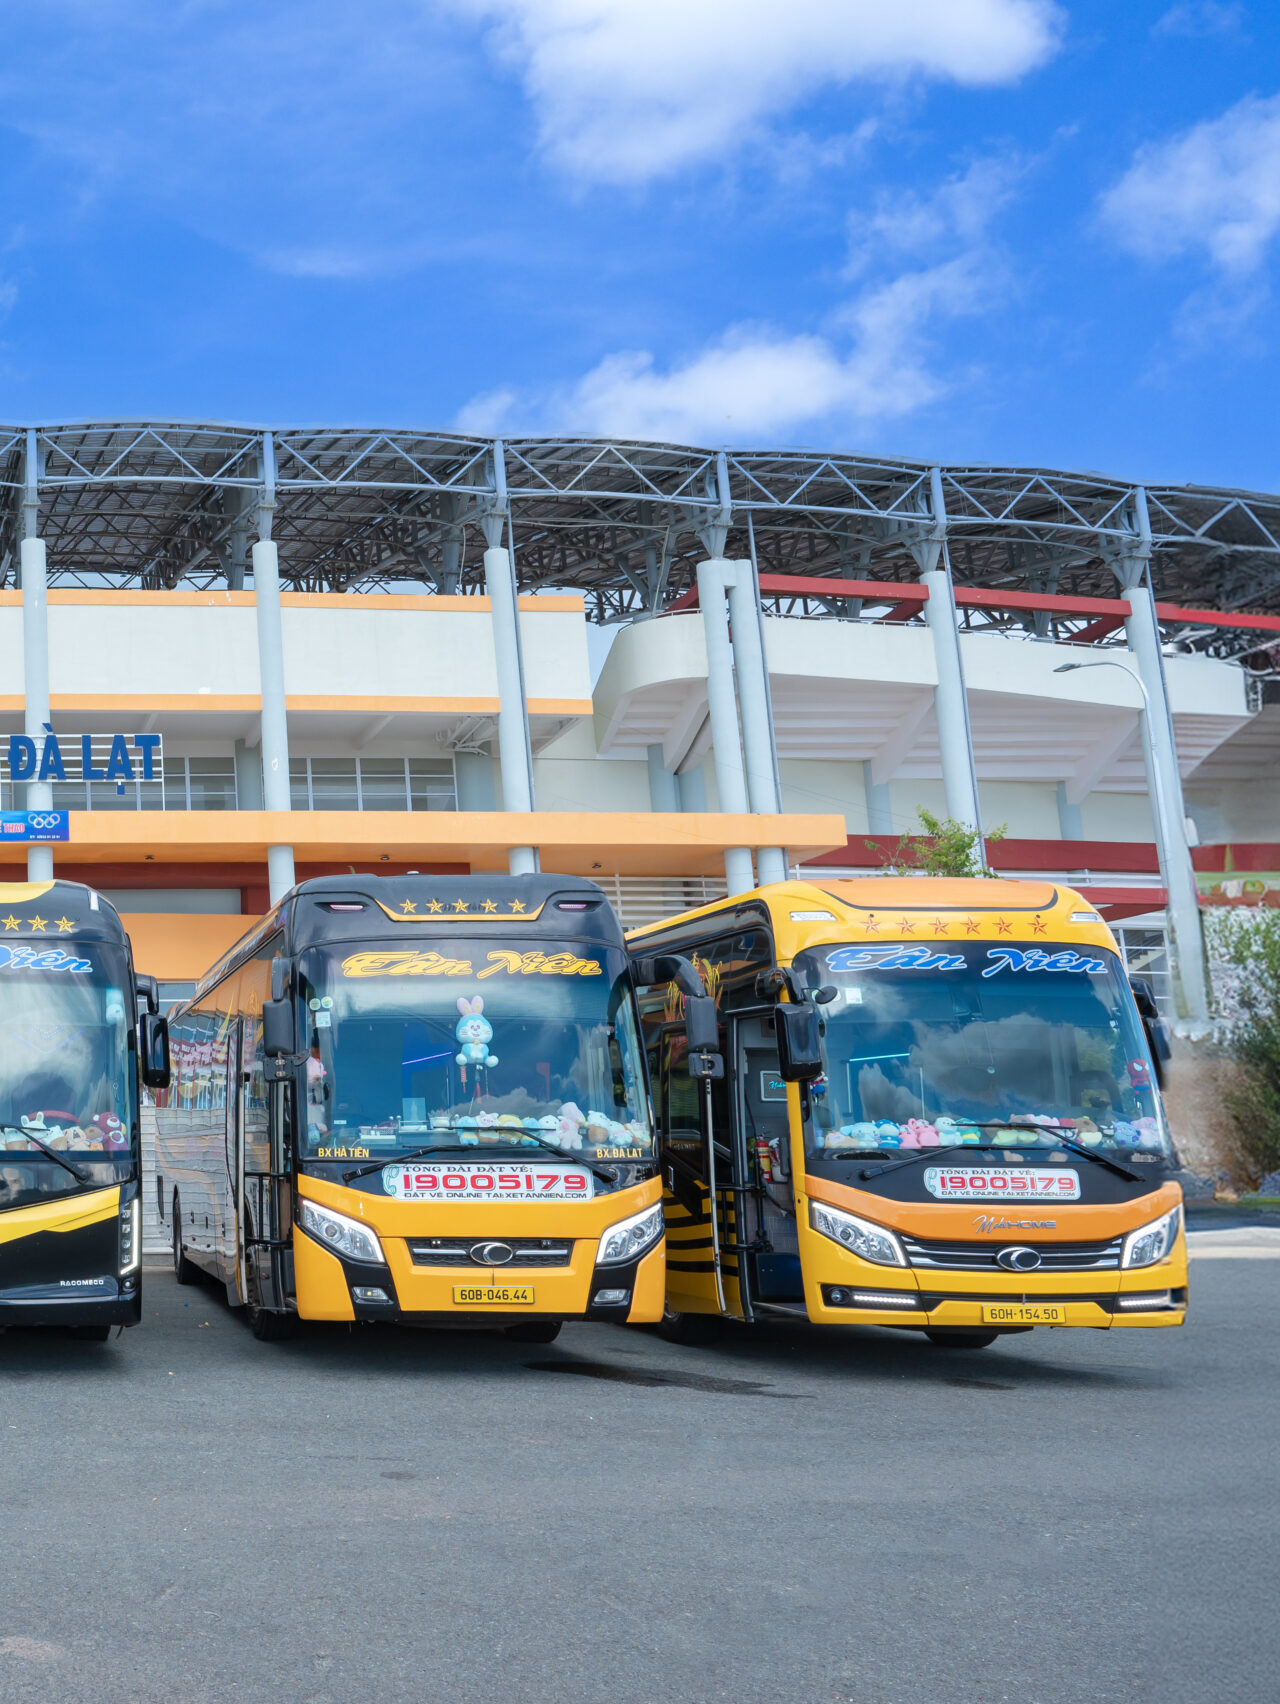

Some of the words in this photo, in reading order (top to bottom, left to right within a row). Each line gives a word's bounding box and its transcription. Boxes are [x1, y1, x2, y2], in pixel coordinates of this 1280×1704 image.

[7, 722, 67, 781] ĐÀ
[81, 734, 161, 795] LẠT
[3, 823, 25, 834] THAO
[348, 1146, 369, 1158] TIÊN
[403, 1174, 588, 1191] 19005179
[940, 1176, 1076, 1191] 19005179
[460, 1289, 528, 1301] 60B-046.44
